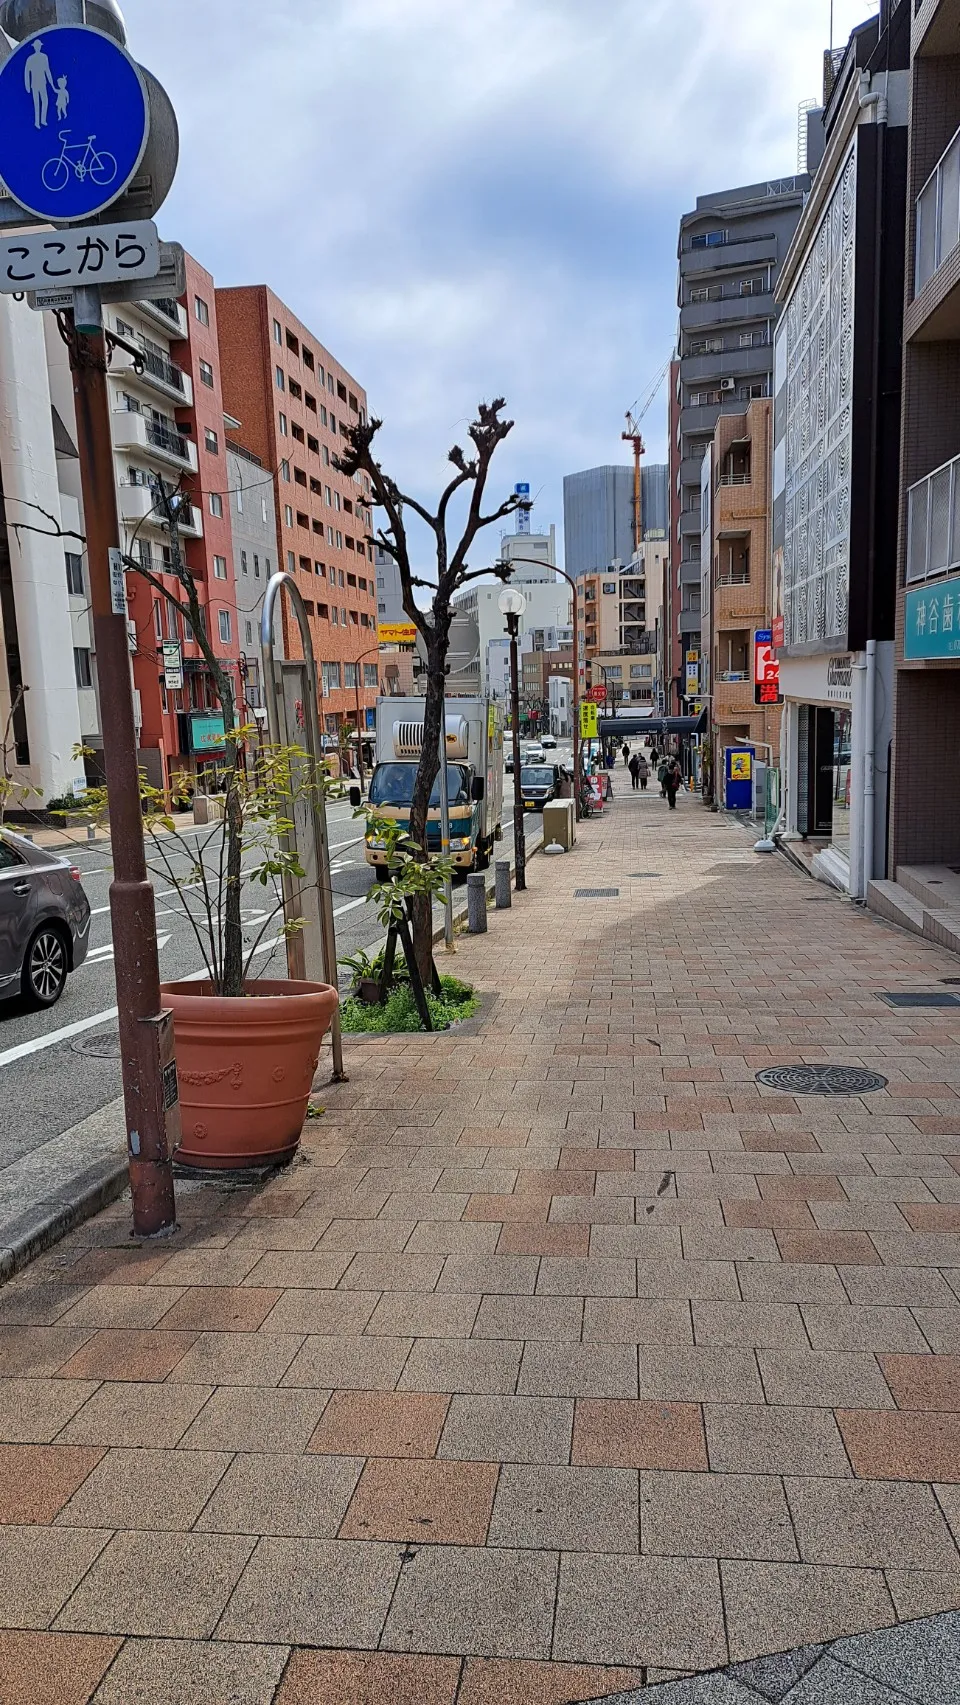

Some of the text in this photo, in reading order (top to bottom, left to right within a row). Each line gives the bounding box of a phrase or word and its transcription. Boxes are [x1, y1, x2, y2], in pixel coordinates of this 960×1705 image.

[7, 234, 146, 281] ここから
[760, 684, 778, 702] 満
